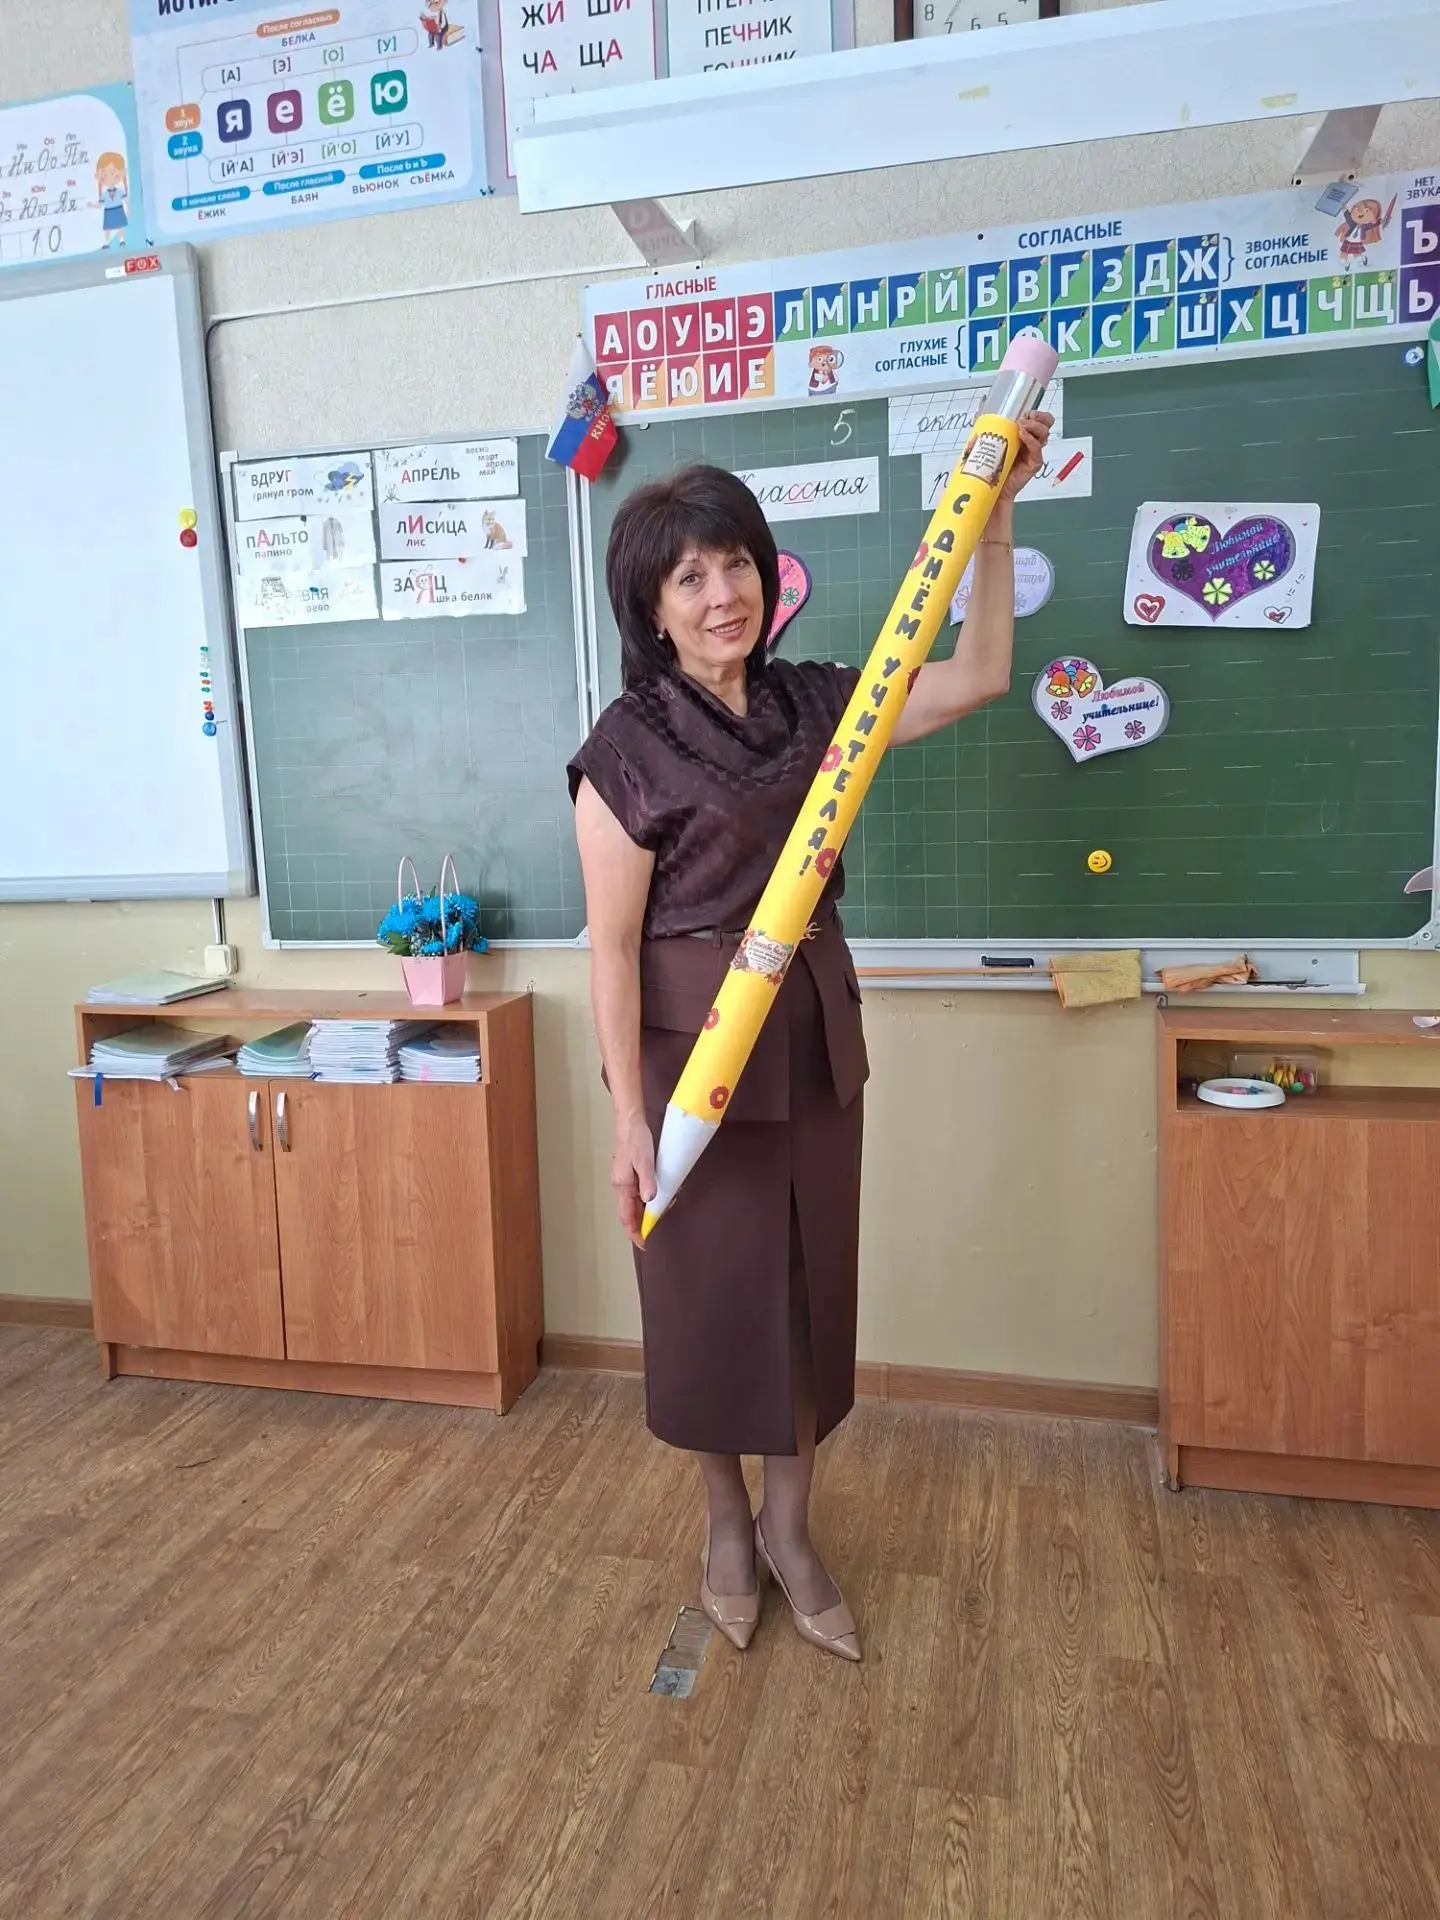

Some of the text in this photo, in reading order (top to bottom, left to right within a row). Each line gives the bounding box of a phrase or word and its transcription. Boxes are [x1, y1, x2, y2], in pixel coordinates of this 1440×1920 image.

[521, 0, 564, 29] ЖИ
[925, 4, 935, 21] 8
[281, 32, 316, 47] БЕЛКА
[705, 15, 793, 48] ПЕЧНИК
[523, 38, 623, 74] ЧА ЩА
[377, 161, 404, 174] После
[274, 173, 334, 192] После гласной
[352, 170, 455, 195] ВЬЮНОК СЪЁМКА
[1414, 176, 1436, 187] НЕТ
[291, 192, 319, 205] БАЯН
[1018, 220, 1123, 249] СОГЛАСНЫЕ
[1246, 233, 1309, 254] ЗВОНКИЕ
[1245, 249, 1329, 270] СОГЛАСНЫЕ
[646, 276, 717, 299] ГЛАСНЫЕ
[900, 336, 948, 354] ГЛУХИЕ
[875, 352, 948, 372] СОГЛАСНЫЕ
[830, 408, 857, 446] 5
[465, 446, 490, 454] весна
[478, 453, 499, 462] март
[251, 469, 292, 489] ВДРУГ
[401, 466, 461, 485] АПРЕЛЬ
[253, 488, 314, 502] грянул гром
[406, 538, 426, 547] лис
[393, 571, 447, 604] ЗАЯЦ
[461, 591, 493, 601] беляк
[799, 493, 972, 877] С ДНЁМ УЧИТЕЛЯ!
[1082, 695, 1160, 725] учительнице!
